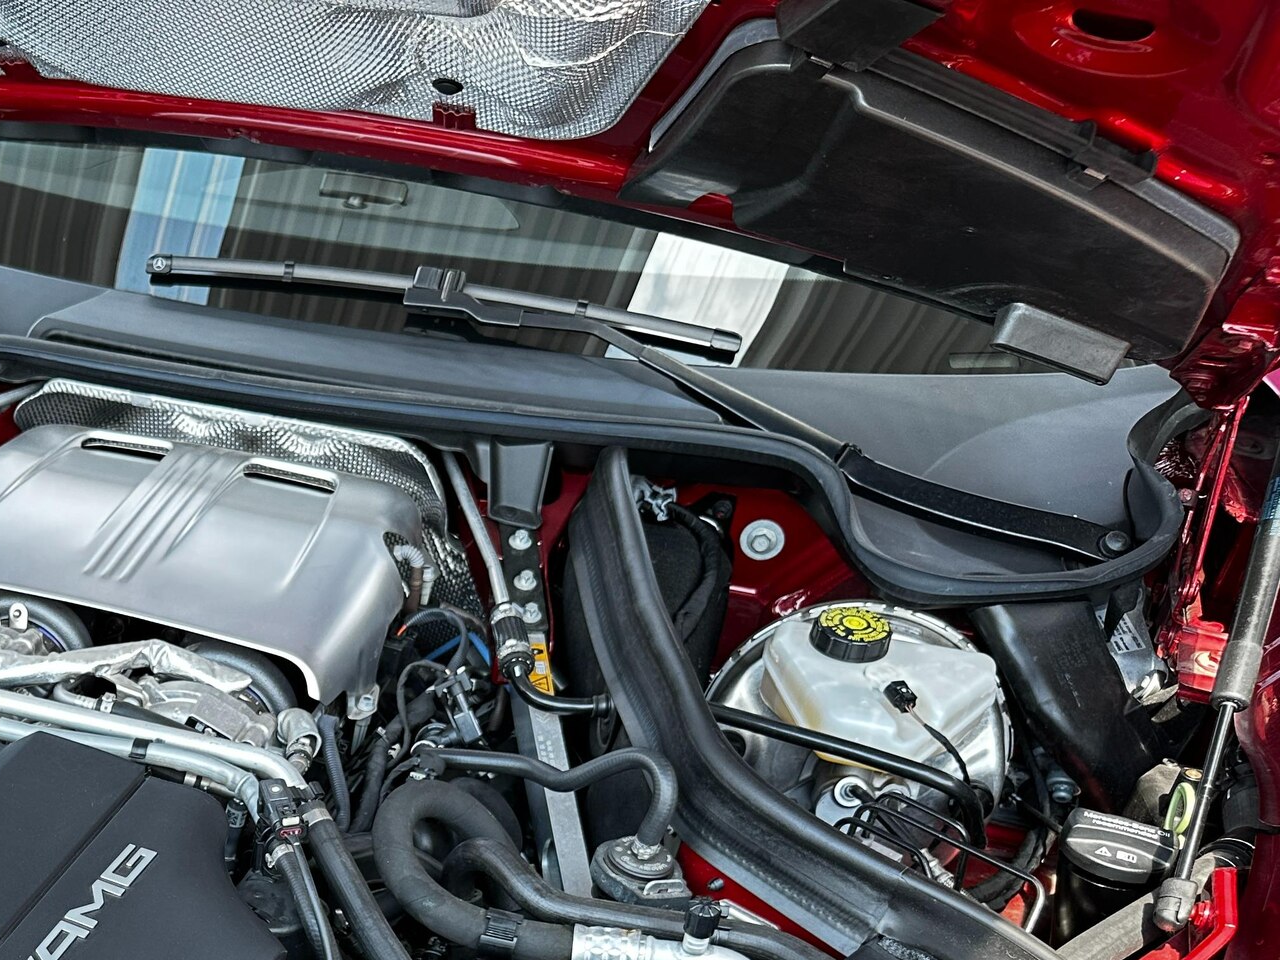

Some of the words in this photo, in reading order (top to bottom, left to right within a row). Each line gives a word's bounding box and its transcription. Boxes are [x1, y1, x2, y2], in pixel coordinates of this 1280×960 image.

[1083, 810, 1156, 834] Mercedes-Benz
[1157, 829, 1171, 838] Oil
[1092, 818, 1159, 841] recommended
